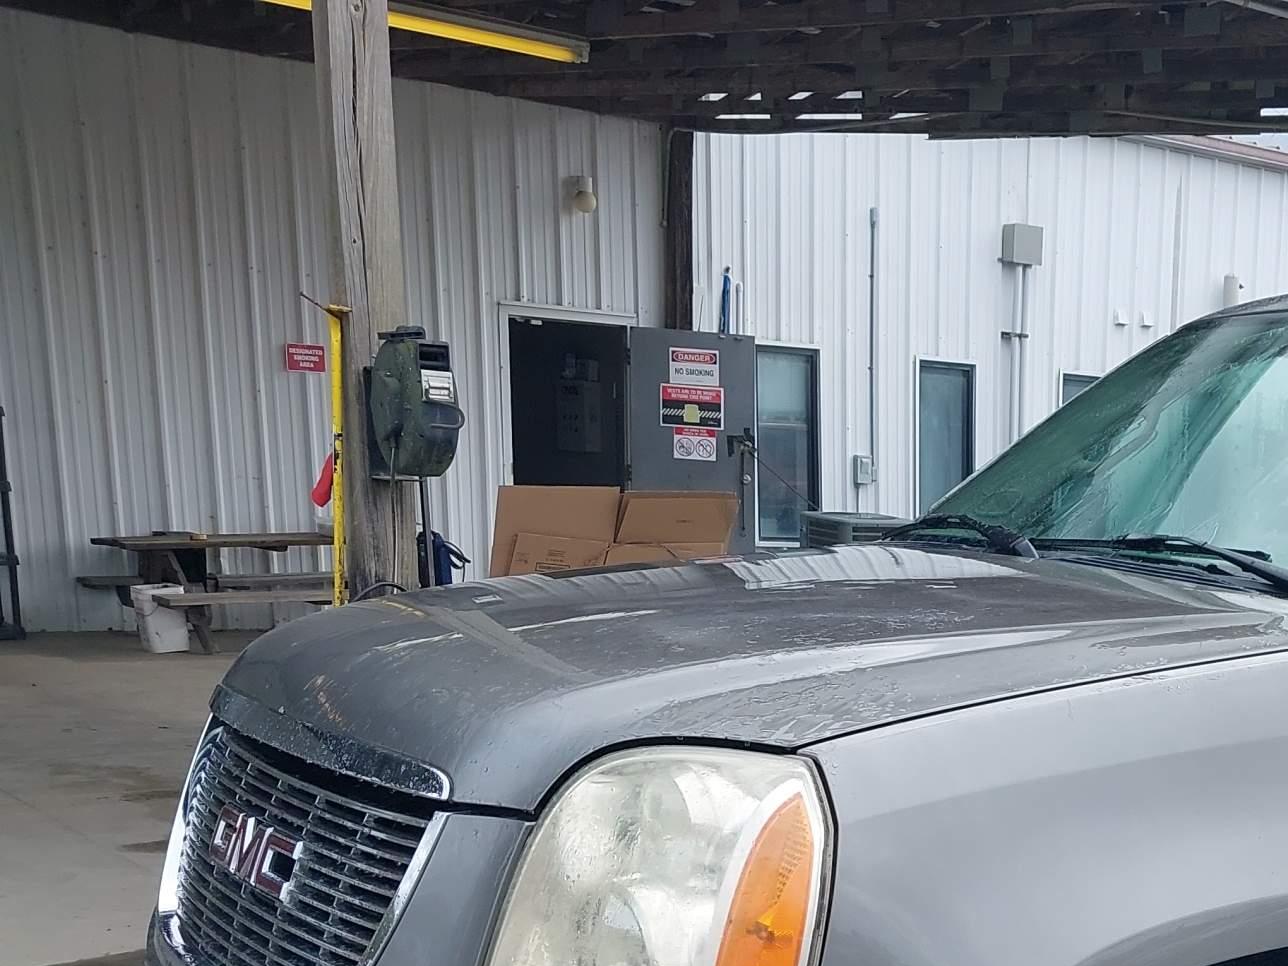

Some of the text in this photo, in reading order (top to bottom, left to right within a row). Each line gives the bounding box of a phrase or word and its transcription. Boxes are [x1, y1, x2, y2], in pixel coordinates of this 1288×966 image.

[678, 353, 711, 362] DANGER
[685, 368, 714, 377] SMOKING
[209, 802, 304, 903] GMC
